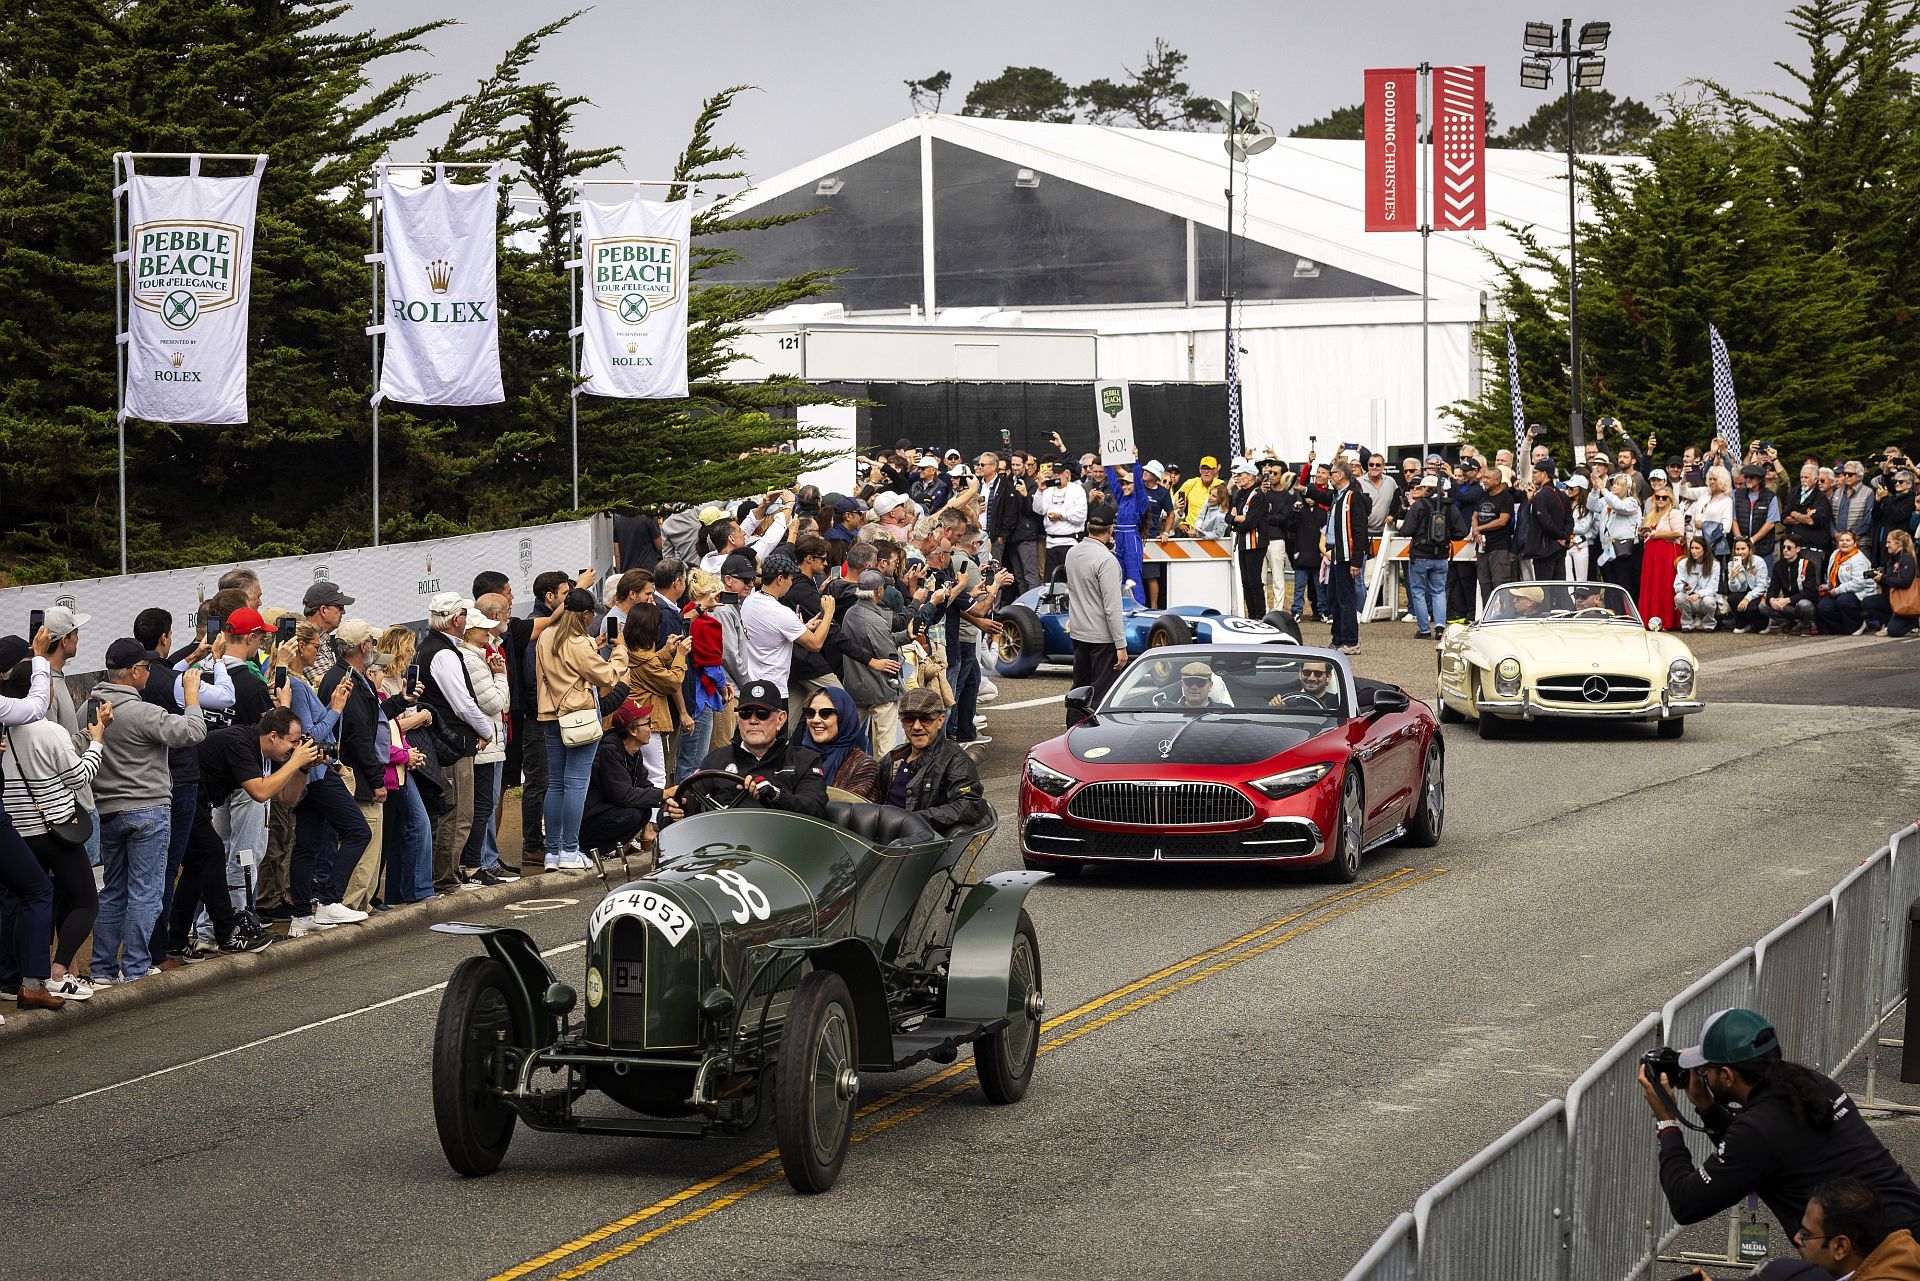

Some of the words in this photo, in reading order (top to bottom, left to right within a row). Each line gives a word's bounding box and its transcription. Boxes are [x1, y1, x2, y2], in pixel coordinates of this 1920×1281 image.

[142, 231, 230, 255] PEBBLE
[598, 245, 672, 264] PEBBLE
[139, 254, 229, 279] BEACH
[597, 264, 671, 283] BEACH
[139, 278, 165, 289] TOUR
[166, 277, 228, 291] d'ELEGANCE
[596, 284, 620, 292] TOUR
[391, 299, 489, 323] ROLEX
[778, 336, 799, 350] 121
[612, 357, 653, 367] ROLEX
[154, 370, 202, 382] ROLEX
[1103, 389, 1120, 398] PEBBLE
[1104, 396, 1121, 405] BEACH
[1107, 438, 1127, 454] GO!
[418, 578, 441, 595] ROLEX
[695, 869, 771, 925] 38
[60, 981, 79, 995] N
[1741, 1242, 1767, 1252] MEDIA
